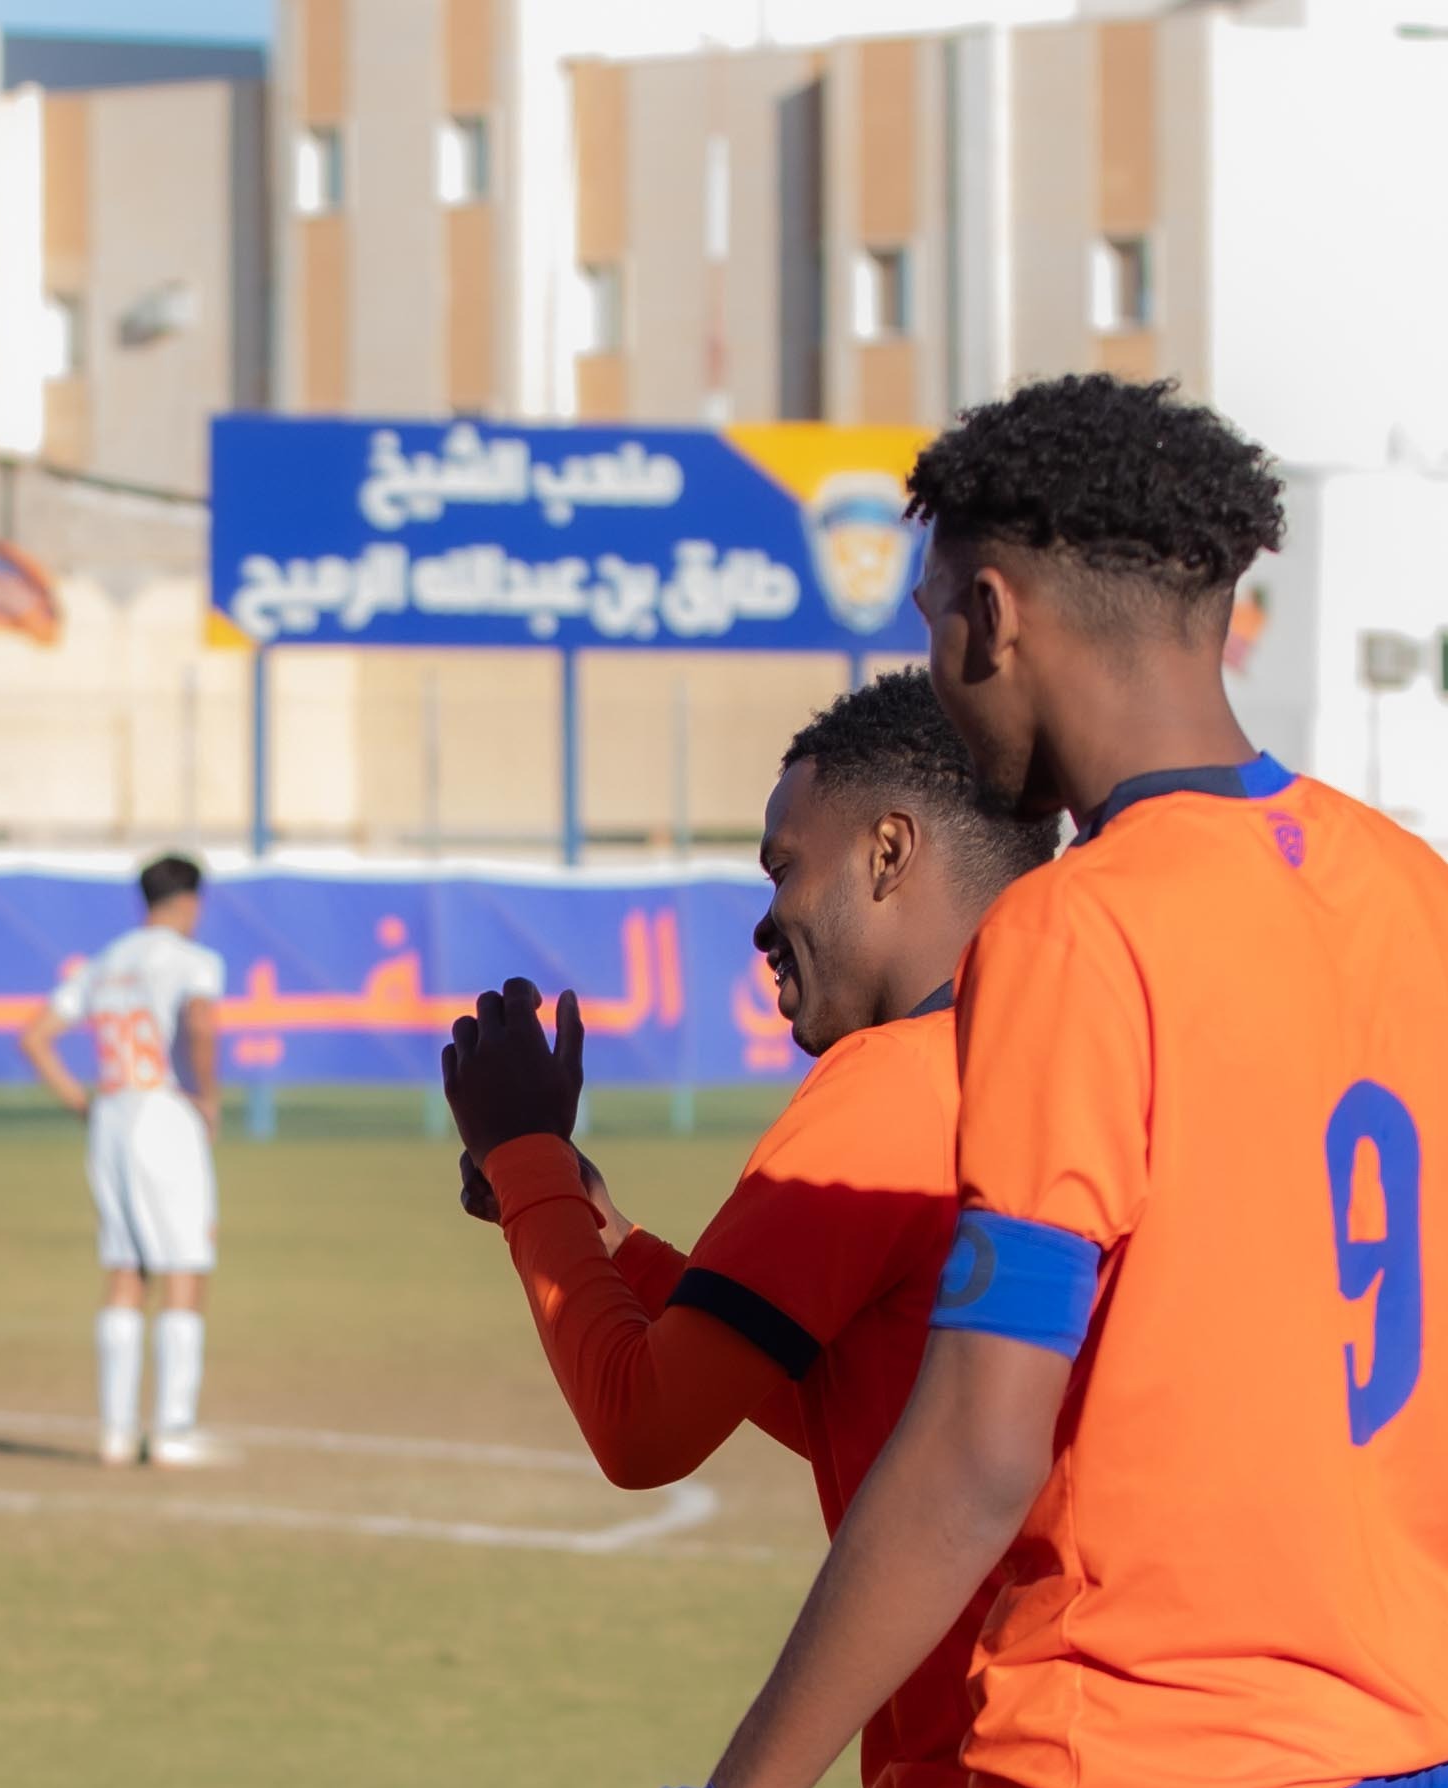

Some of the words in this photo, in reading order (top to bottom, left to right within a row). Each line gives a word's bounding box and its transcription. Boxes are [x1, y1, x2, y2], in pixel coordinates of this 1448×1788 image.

[358, 422, 531, 531] الشيخ
[532, 441, 684, 529] ملعب
[232, 542, 410, 641] الرميح
[590, 553, 659, 640] بن
[660, 539, 801, 638] طارق
[1327, 1082, 1421, 1444] 9
